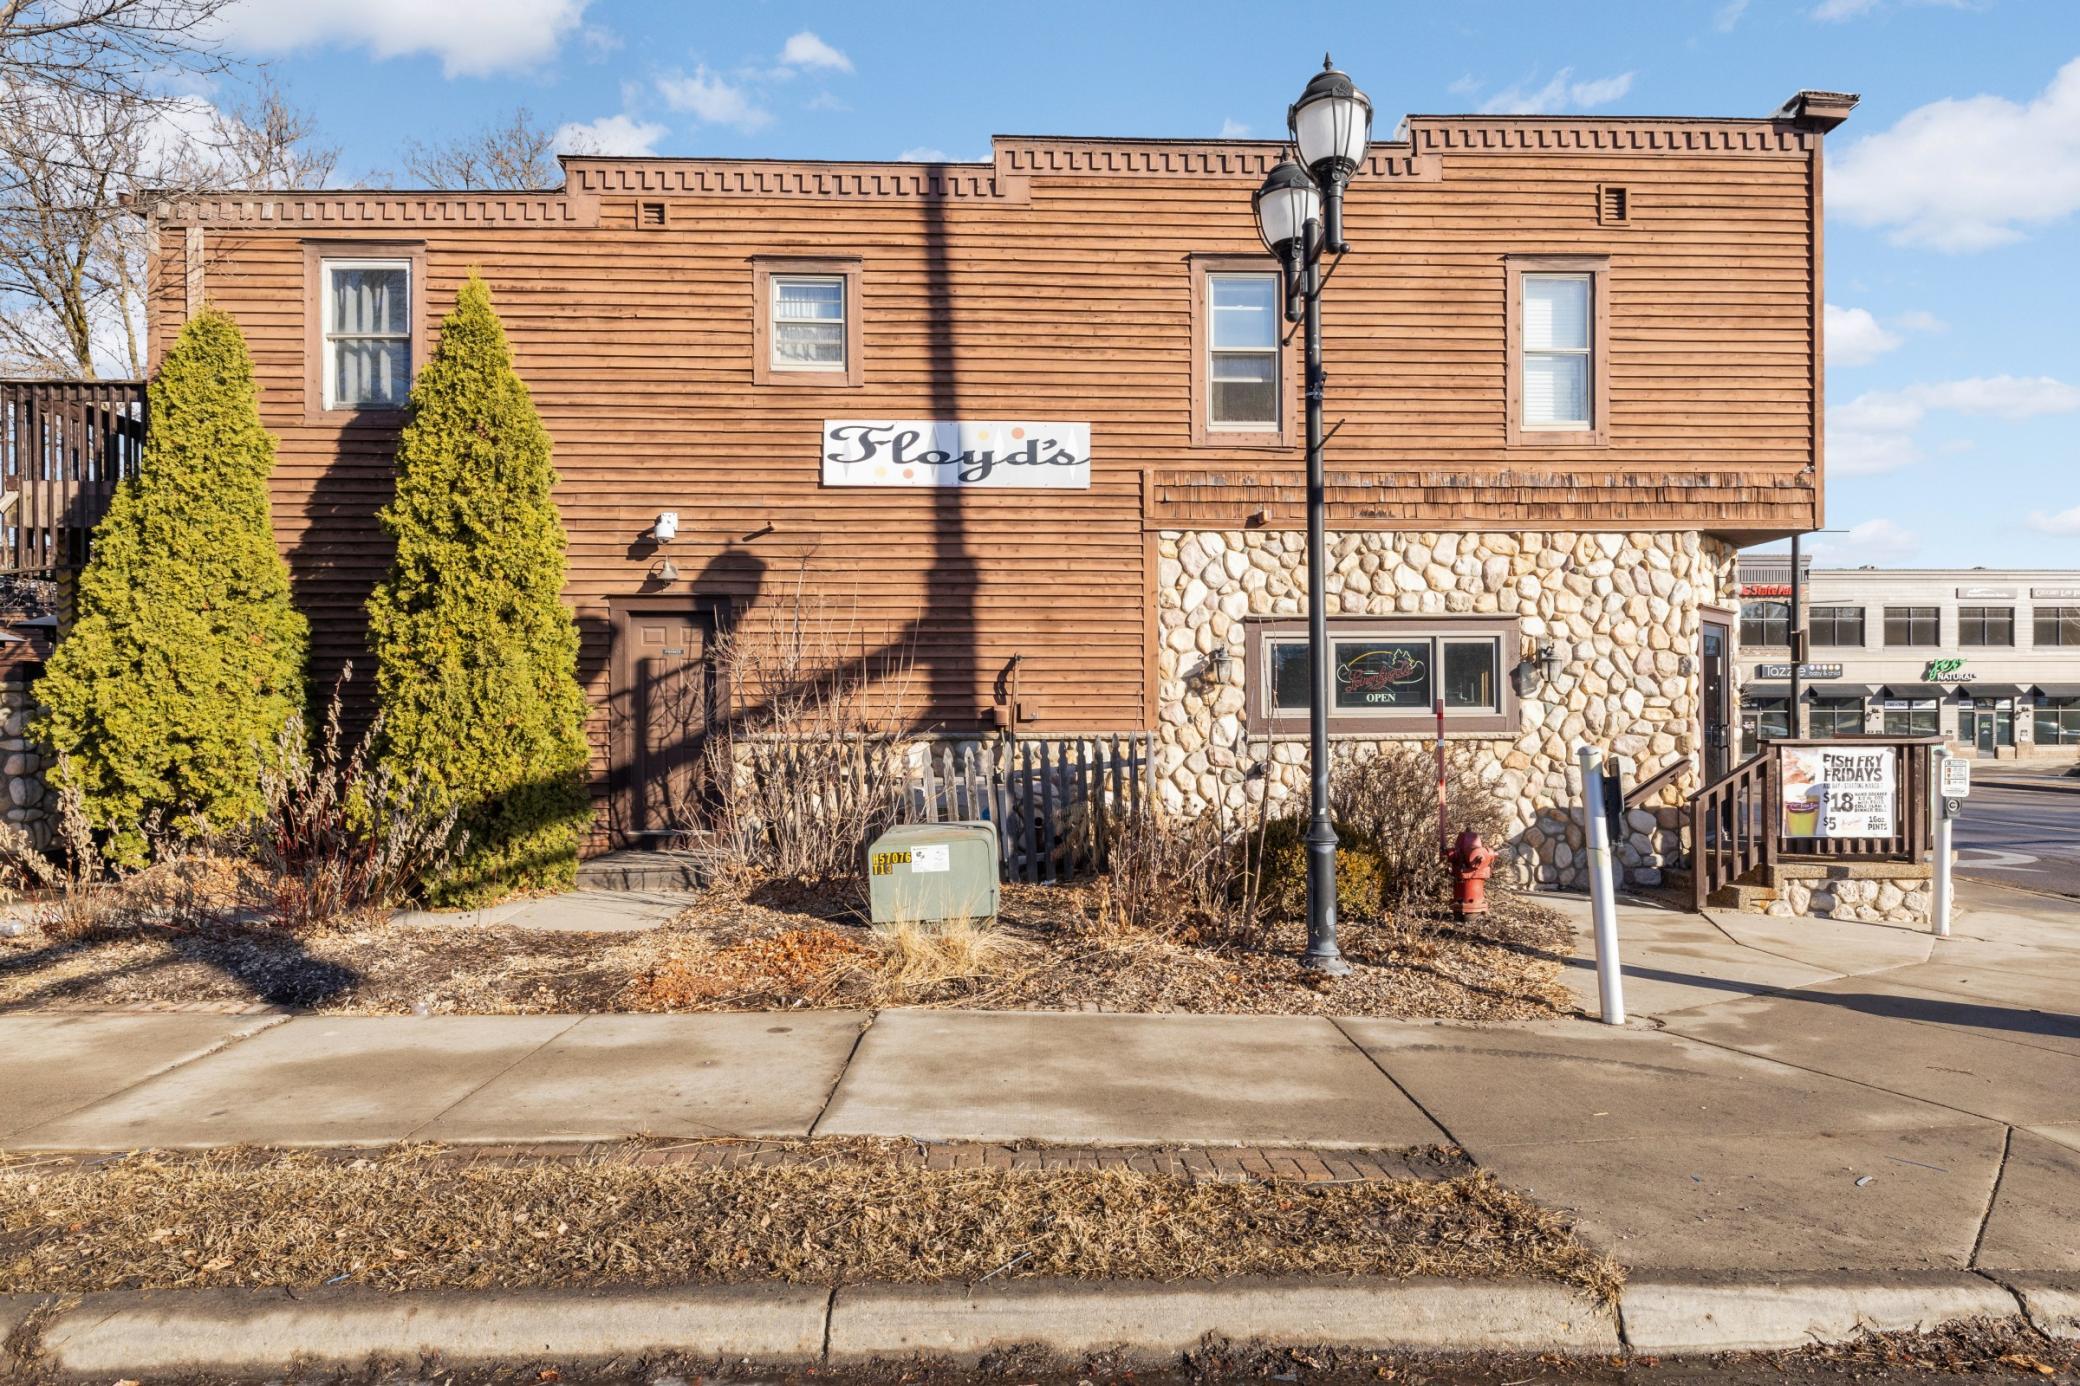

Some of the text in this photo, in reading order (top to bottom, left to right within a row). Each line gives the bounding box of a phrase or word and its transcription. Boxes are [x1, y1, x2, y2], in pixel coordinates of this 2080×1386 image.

[827, 424, 1090, 482] Floyd's
[1765, 665, 1807, 677] Tazze
[1366, 693, 1396, 702] OPEN
[1823, 753, 1883, 767] FISH FRY
[1823, 768, 1883, 782] FRIDAYS
[1823, 791, 1854, 812] $18
[1823, 816, 1836, 830] $5
[1867, 823, 1888, 831] PINTS
[872, 864, 893, 875] T13
